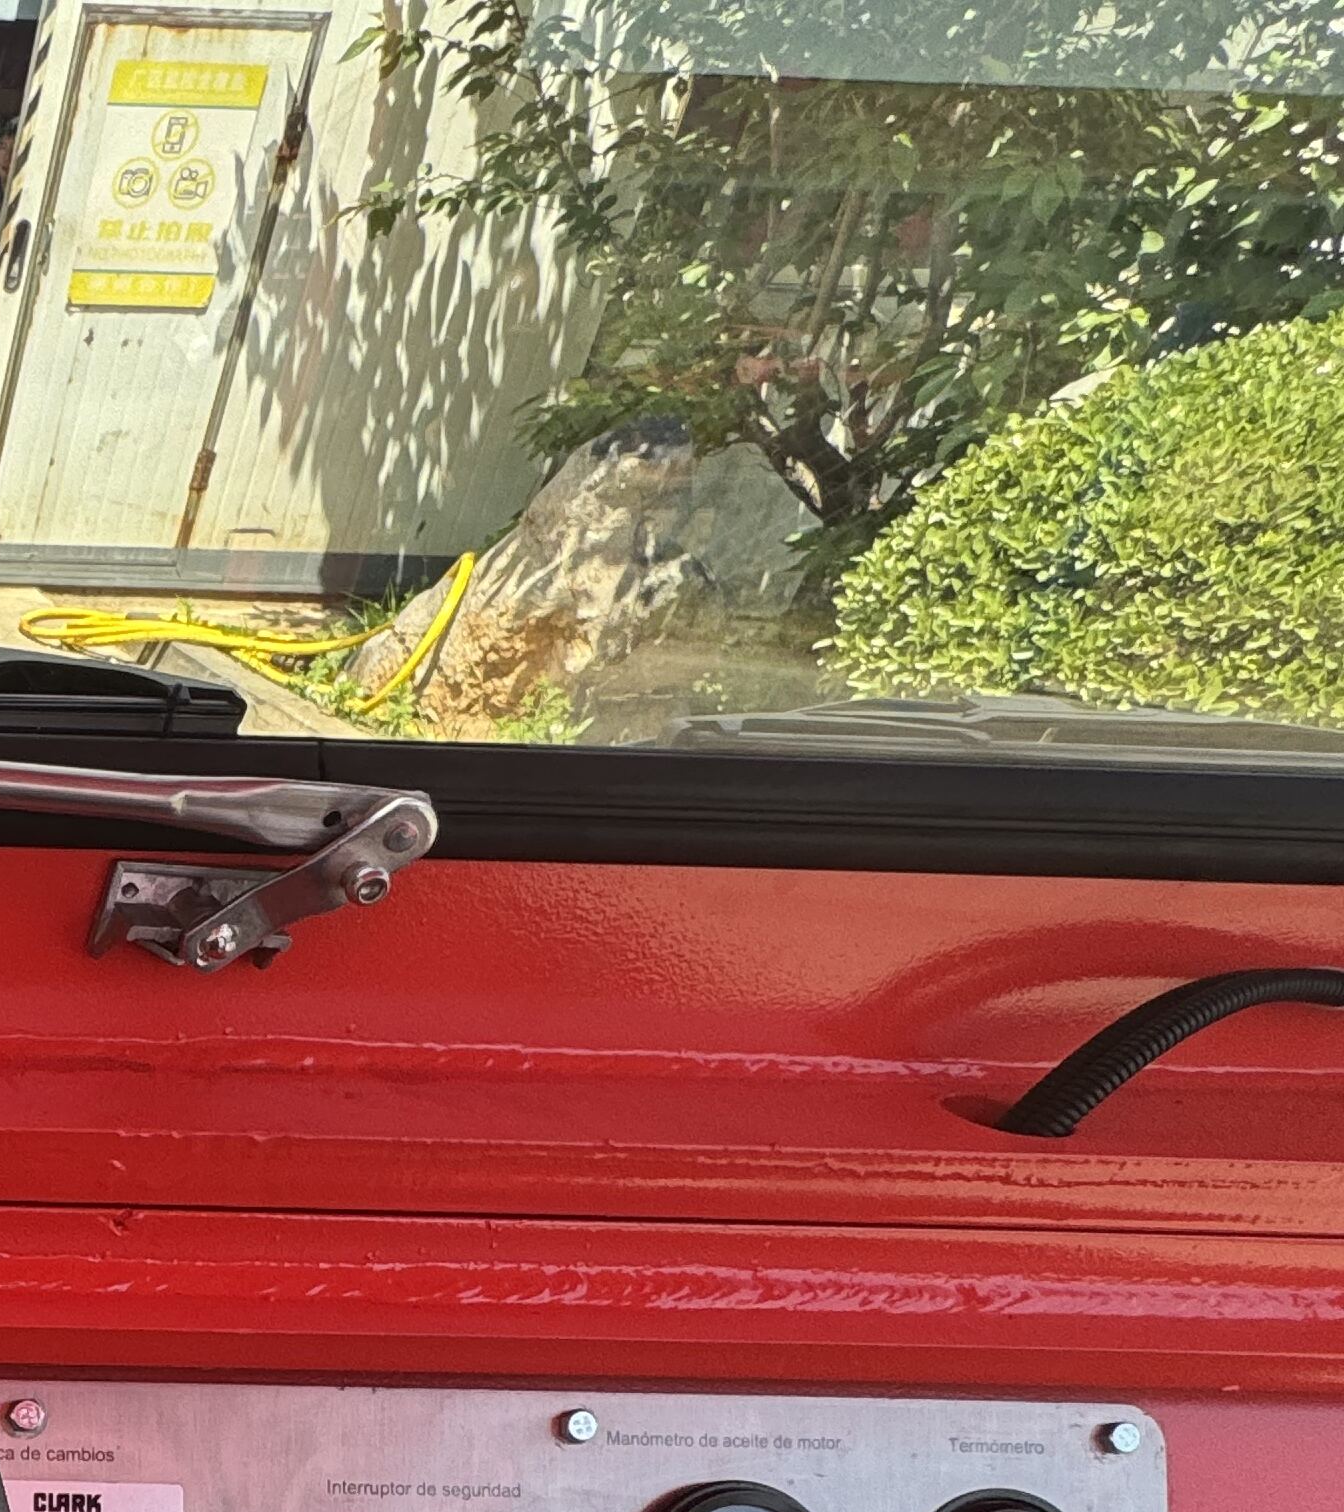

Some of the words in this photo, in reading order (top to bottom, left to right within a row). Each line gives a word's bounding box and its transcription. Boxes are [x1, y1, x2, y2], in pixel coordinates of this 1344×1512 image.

[606, 1430, 694, 1447] Manómetro
[698, 1433, 718, 1447] de
[722, 1433, 768, 1448] aceite
[773, 1434, 792, 1449] de
[797, 1436, 842, 1450] motor
[948, 1437, 1045, 1455] Termómetro
[20, 1446, 41, 1461] de
[46, 1446, 115, 1462] cambios
[326, 1480, 411, 1499] Interruptor
[416, 1482, 437, 1496] de
[442, 1483, 521, 1501] seguridad
